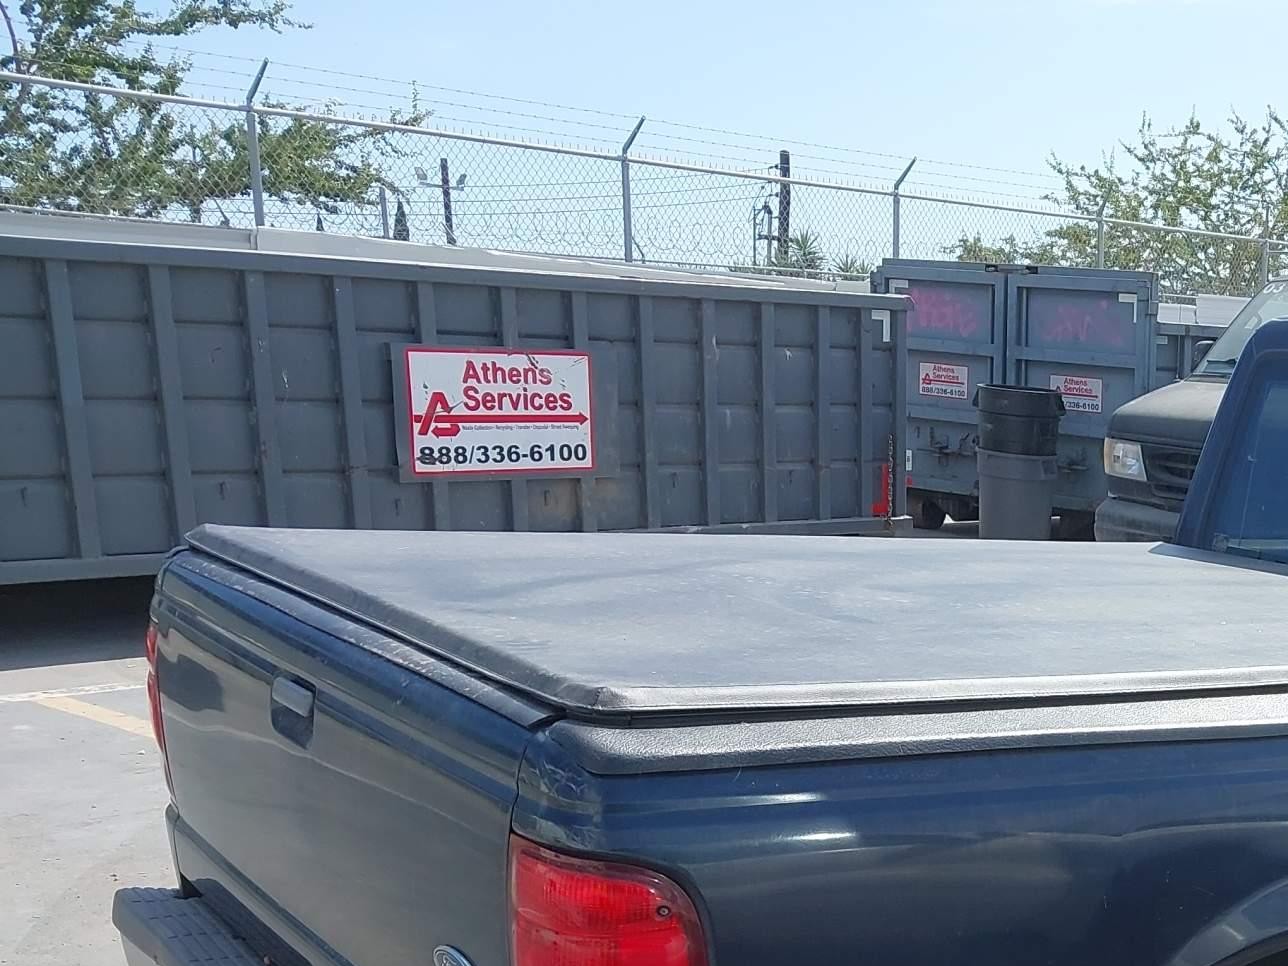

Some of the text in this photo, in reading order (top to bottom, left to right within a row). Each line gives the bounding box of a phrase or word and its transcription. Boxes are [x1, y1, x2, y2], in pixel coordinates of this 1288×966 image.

[462, 360, 552, 385] Athens
[932, 365, 955, 374] Athens
[932, 372, 960, 381] Services
[1064, 377, 1088, 386] Athens
[1063, 385, 1093, 394] Services
[463, 386, 573, 412] Services
[1065, 401, 1100, 411] /336-6100
[418, 443, 587, 465] 888/336-6100
